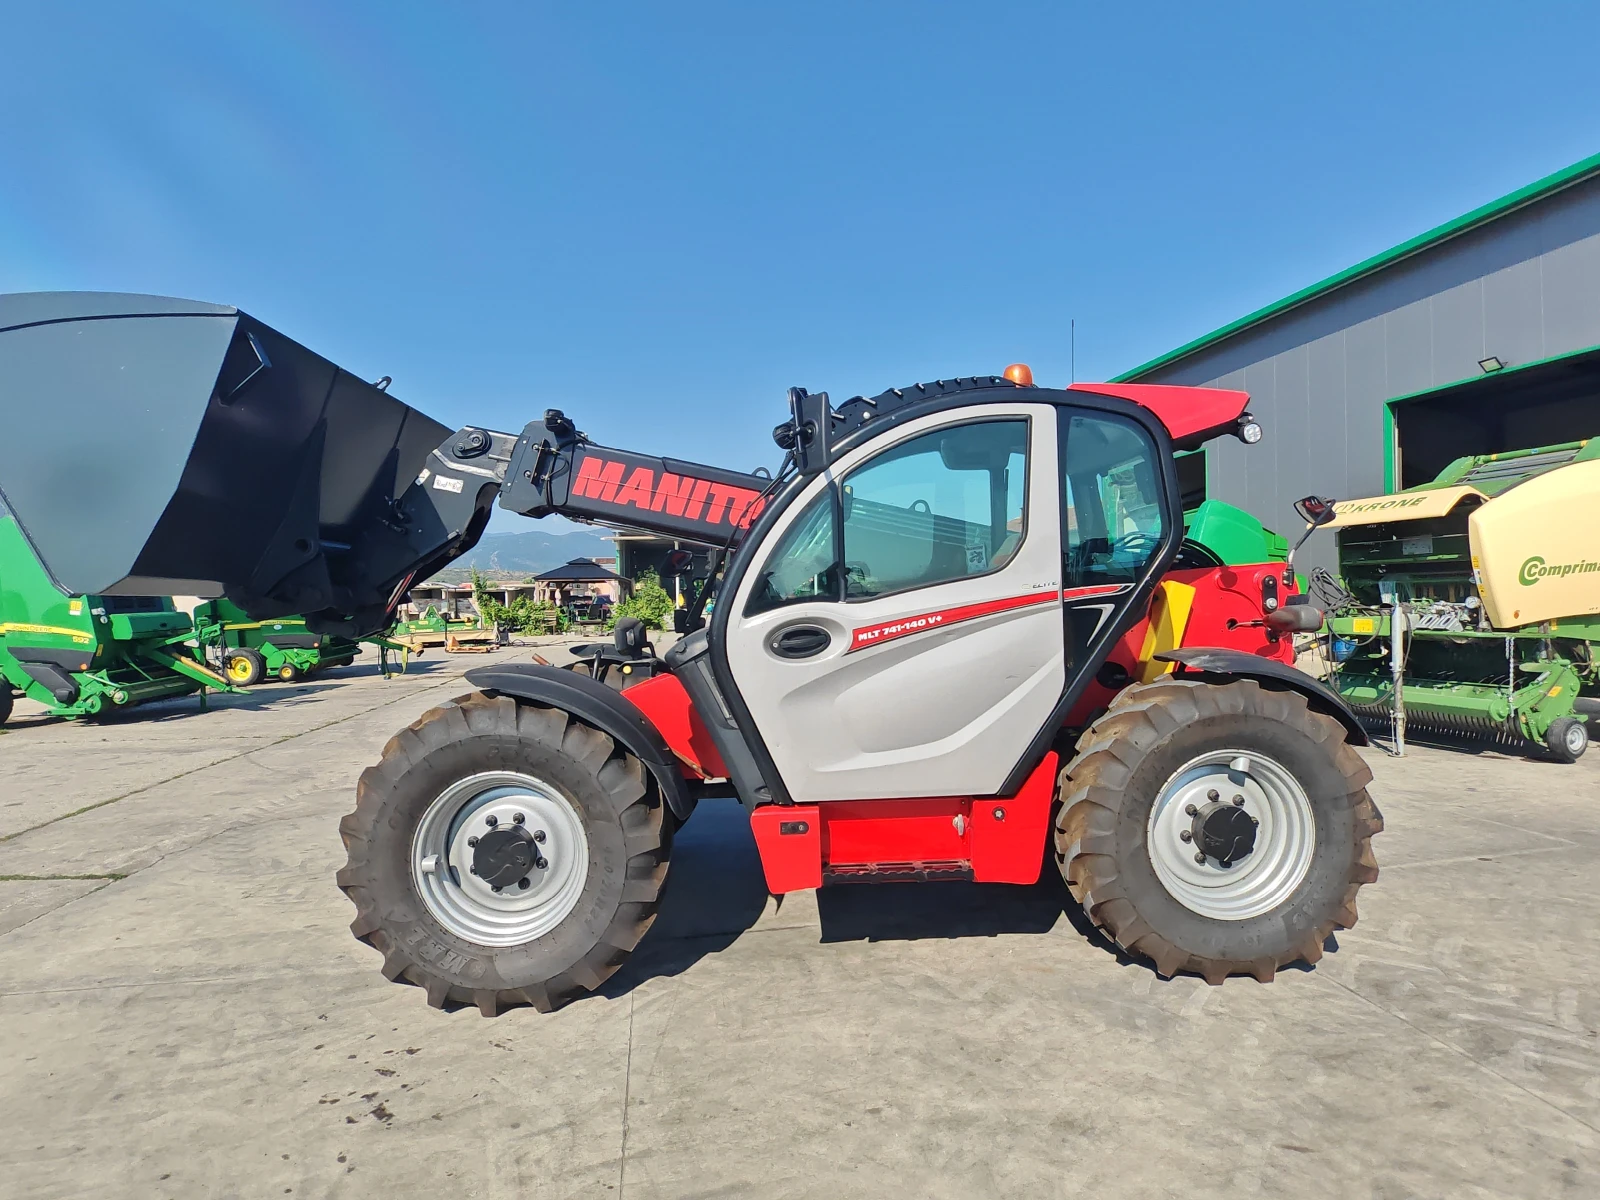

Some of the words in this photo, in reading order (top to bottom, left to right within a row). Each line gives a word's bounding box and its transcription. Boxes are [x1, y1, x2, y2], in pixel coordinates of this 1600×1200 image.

[572, 456, 774, 529] MANITO
[1350, 497, 1428, 513] KRONE
[858, 630, 881, 641] MLT
[882, 619, 927, 635] 741-140
[927, 615, 943, 624] V+
